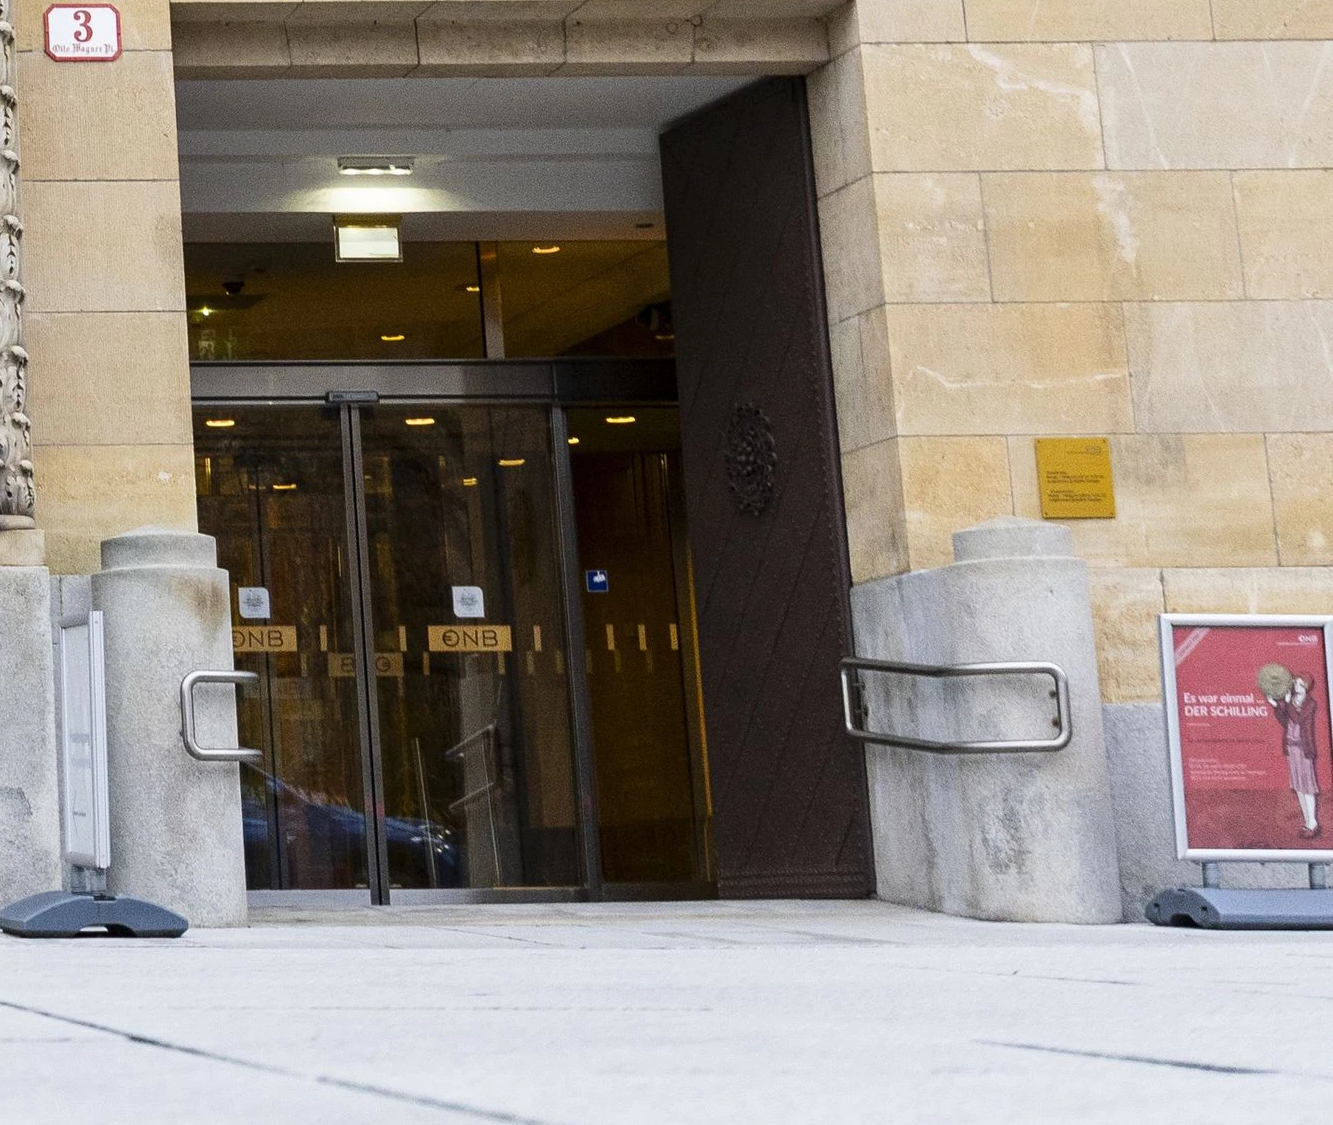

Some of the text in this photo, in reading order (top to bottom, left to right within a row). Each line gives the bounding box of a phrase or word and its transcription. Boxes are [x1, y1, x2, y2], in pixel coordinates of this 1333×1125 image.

[73, 10, 93, 43] 3
[1183, 692, 1197, 704] Es
[1198, 694, 1218, 704] war
[1219, 693, 1255, 704] einmal
[1185, 706, 1268, 717] DER SCHILLING
